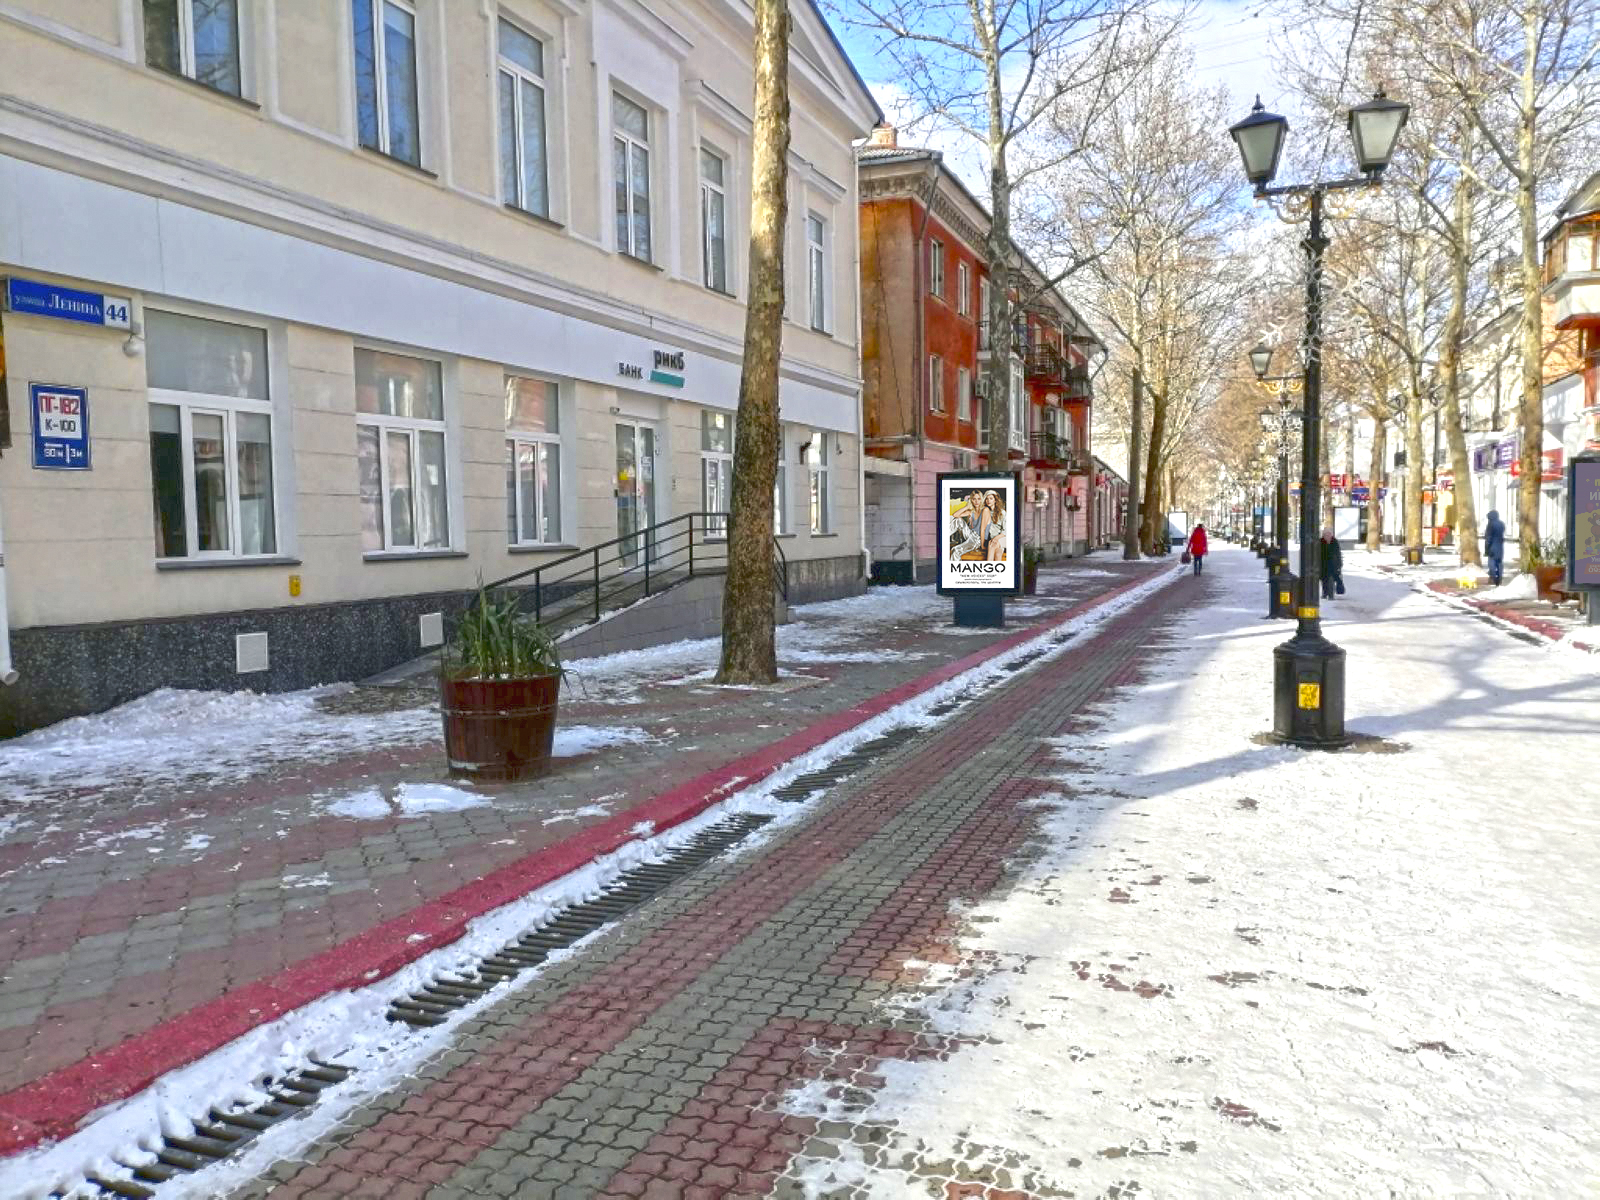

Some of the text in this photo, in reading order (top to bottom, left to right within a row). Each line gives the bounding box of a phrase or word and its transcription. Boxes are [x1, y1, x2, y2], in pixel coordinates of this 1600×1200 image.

[106, 304, 128, 321] 44
[618, 362, 643, 380] БАНК
[40, 395, 79, 415] ПГ-182
[45, 418, 76, 432] К-100
[950, 563, 1006, 573] MANGO
